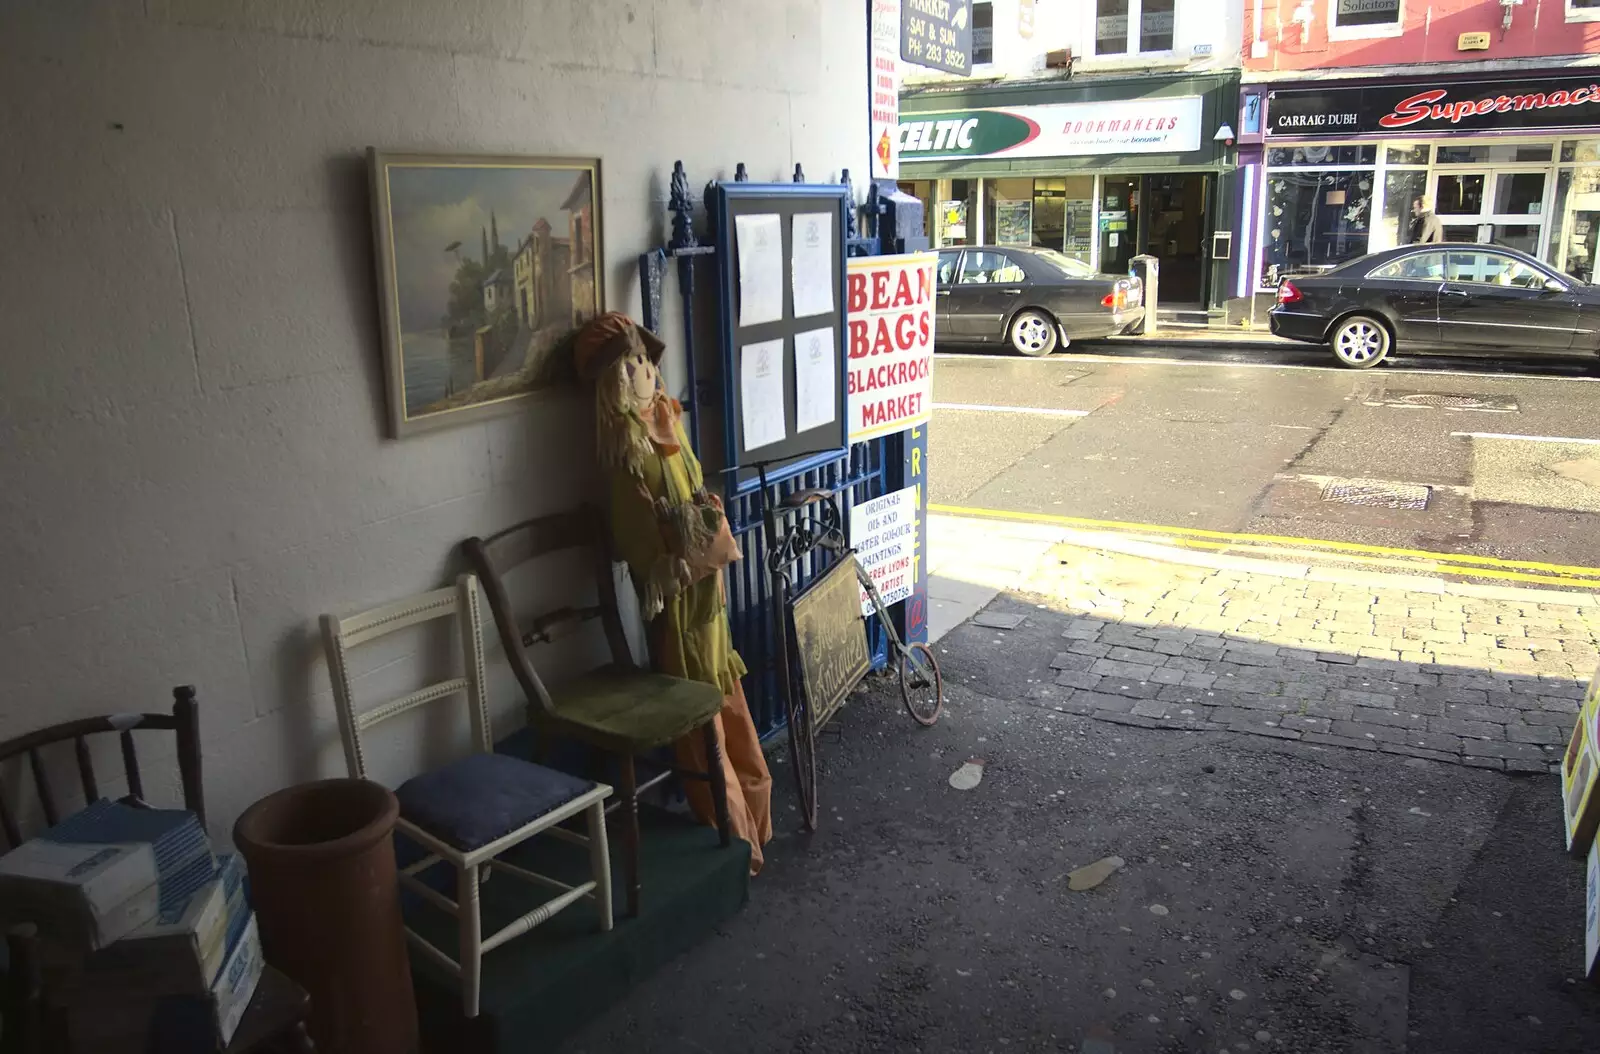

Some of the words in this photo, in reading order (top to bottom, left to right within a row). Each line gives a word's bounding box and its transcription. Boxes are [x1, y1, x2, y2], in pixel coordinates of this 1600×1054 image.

[1342, 0, 1395, 12] Solicitors
[909, 17, 926, 37] SAT
[928, 23, 937, 41] &
[939, 27, 956, 47] SUN
[875, 56, 895, 72] ASIAN
[926, 42, 942, 63] 283
[945, 48, 965, 69] 3522
[877, 75, 893, 90] FOOD
[875, 92, 895, 107] SUPER
[1062, 116, 1178, 134] BOOKMAKERS
[1278, 114, 1326, 127] CARRAIG
[1327, 113, 1358, 125] DUBH
[848, 266, 932, 313] BEAN
[848, 311, 929, 359] BAGS
[848, 356, 929, 394] BLACKROCK
[862, 392, 922, 427] MARKET
[882, 511, 898, 526] AND
[862, 543, 902, 568] PAINTINGS
[888, 556, 910, 574] LYONS
[880, 575, 904, 594] ARTIST
[812, 633, 863, 713] Antiques
